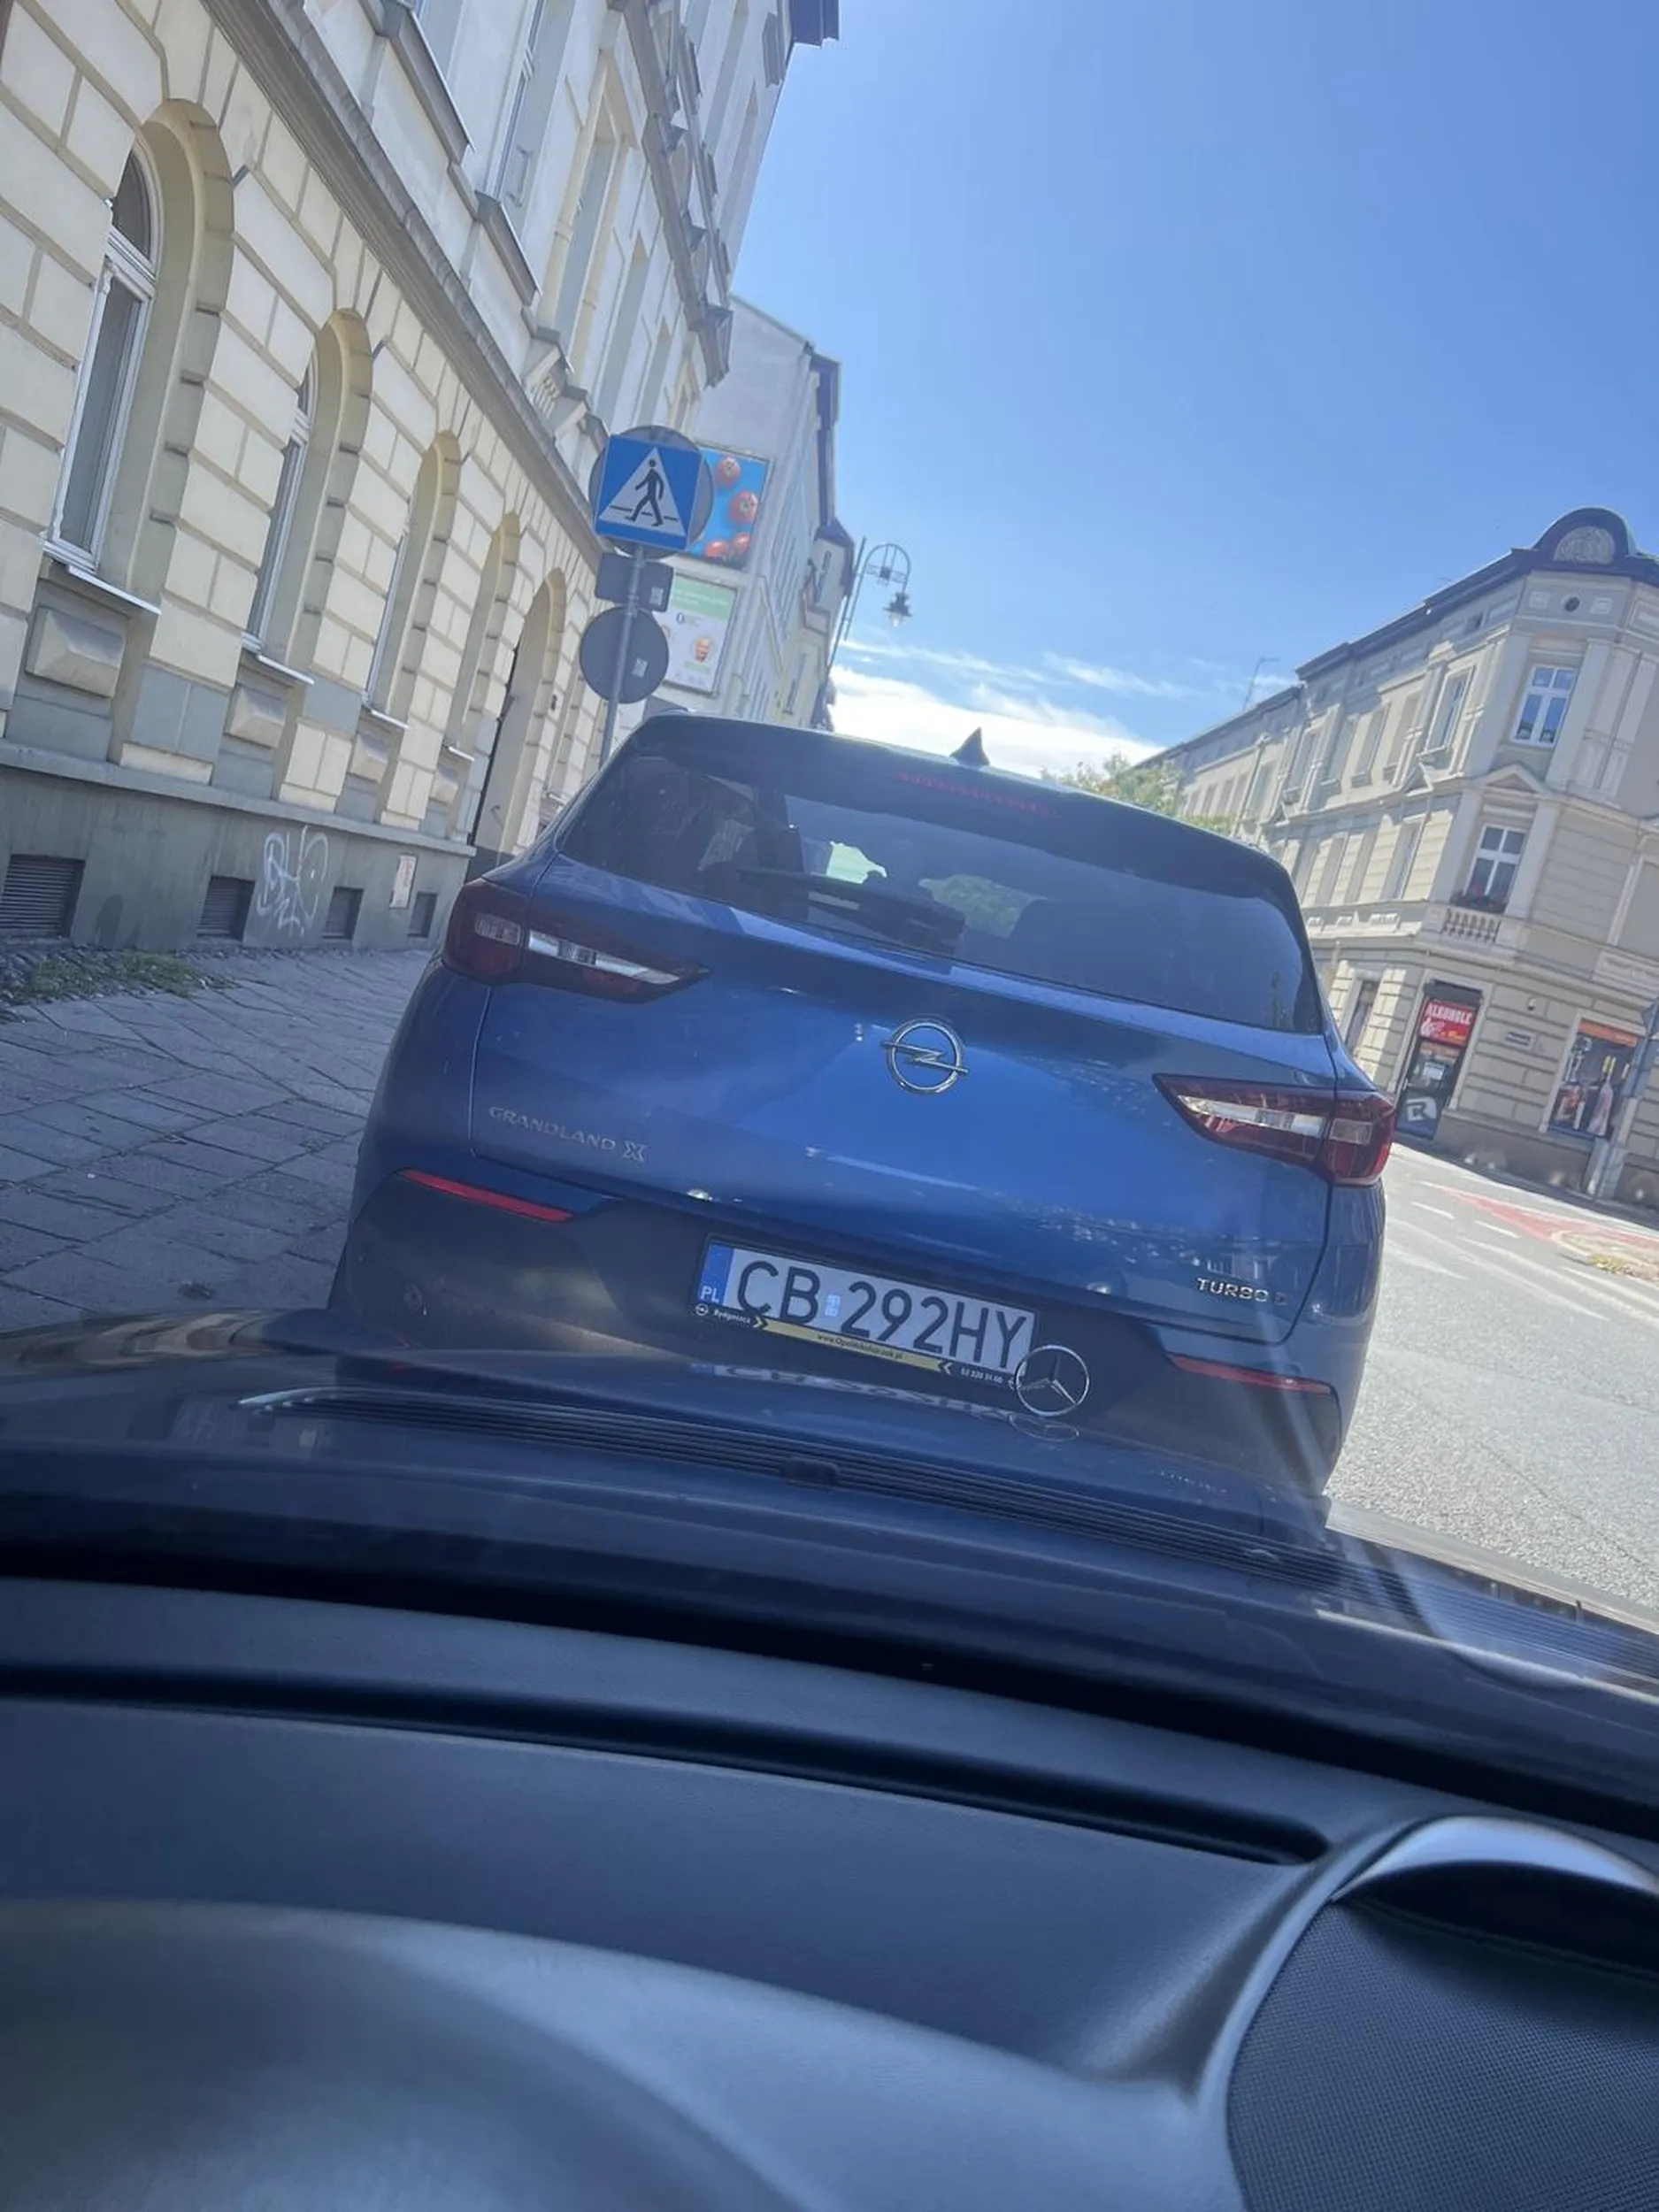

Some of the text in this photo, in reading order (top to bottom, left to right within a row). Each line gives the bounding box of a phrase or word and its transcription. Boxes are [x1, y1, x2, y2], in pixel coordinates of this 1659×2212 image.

[1425, 1002, 1472, 1025] ALKOHOLE
[489, 1106, 648, 1163] GRANDLAND X
[699, 1285, 719, 1303] PL
[1196, 1277, 1270, 1302] TURBO
[737, 1261, 1027, 1369] CB 292HY
